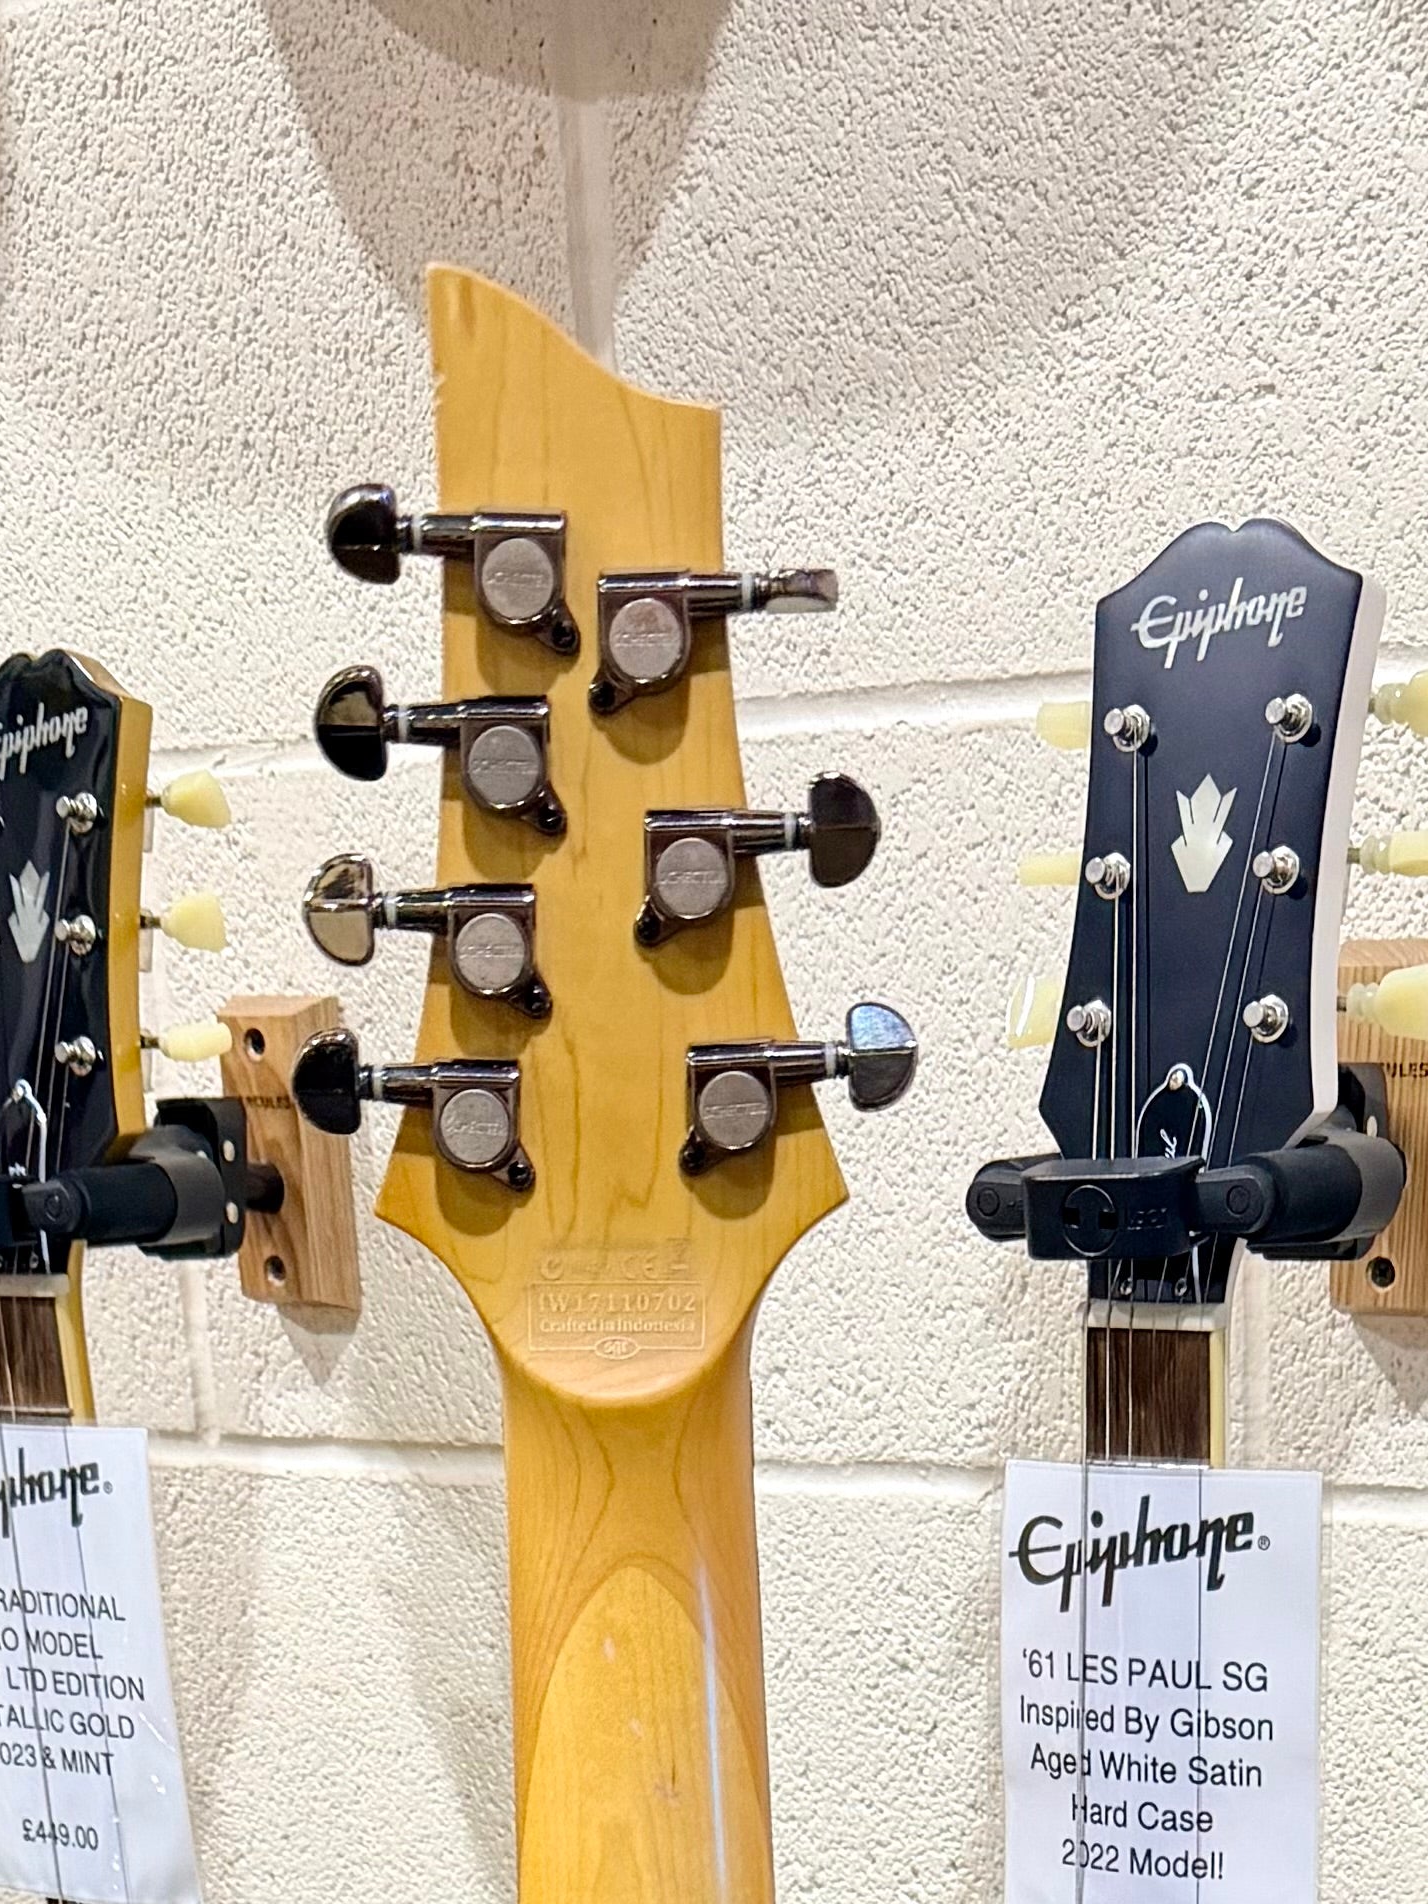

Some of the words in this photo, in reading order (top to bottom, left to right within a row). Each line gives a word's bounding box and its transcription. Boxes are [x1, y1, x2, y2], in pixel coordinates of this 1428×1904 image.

[1131, 577, 1308, 669] Epiphone
[25, 1630, 104, 1661] MODEL
[6, 1666, 47, 1694] LTD
[52, 1670, 145, 1701] EDITION
[1067, 1653, 1117, 1687] LES
[1127, 1657, 1212, 1690] PAUL
[1221, 1661, 1268, 1693] SG
[70, 1707, 136, 1741] GOLD
[1020, 1694, 1114, 1741] Inspired
[1124, 1704, 1160, 1744] By
[1170, 1707, 1274, 1742] Gibson
[42, 1745, 57, 1770] &
[61, 1748, 115, 1778] MINT
[1030, 1742, 1092, 1783] Aged
[1099, 1749, 1177, 1785] White
[1188, 1754, 1262, 1789] Satin
[1071, 1793, 1127, 1829] Hard
[1138, 1801, 1213, 1834] Case
[1128, 1843, 1224, 1881] Model!
